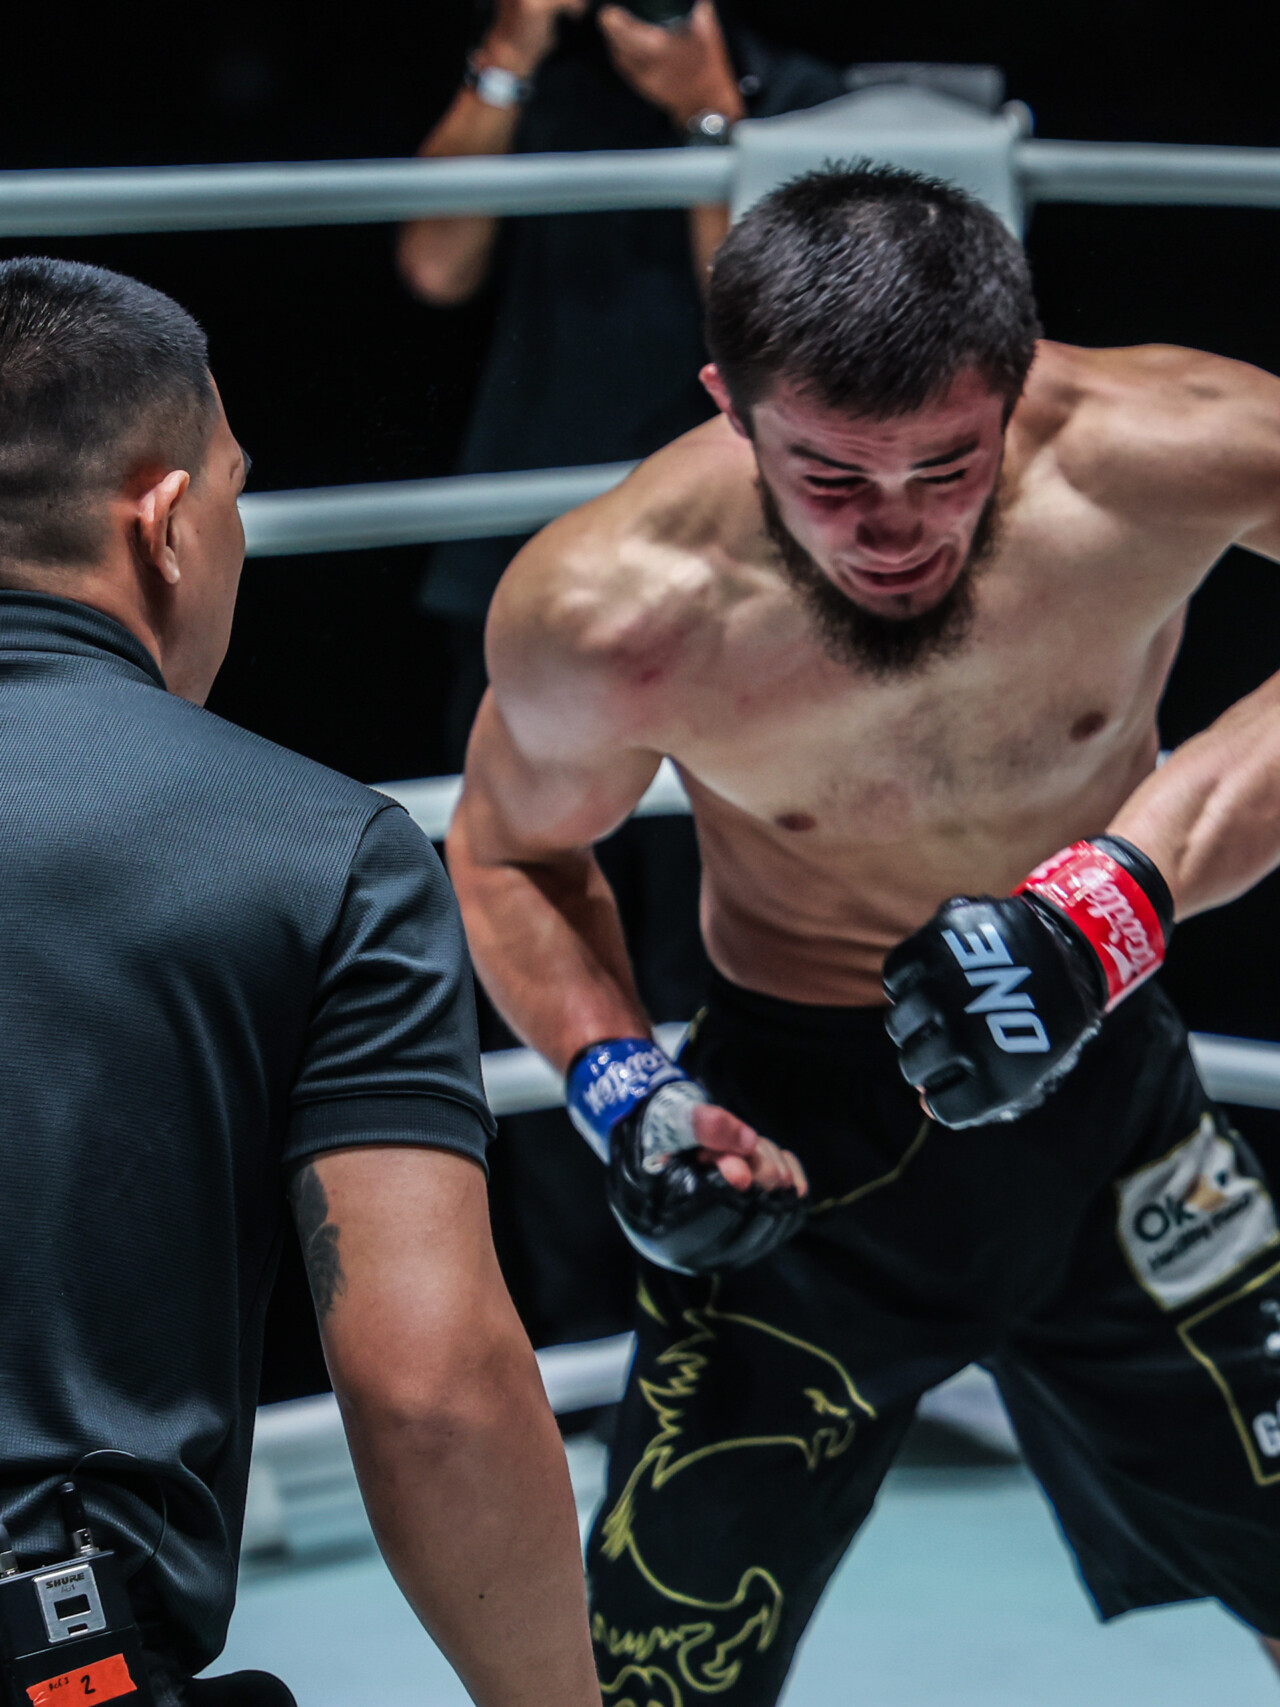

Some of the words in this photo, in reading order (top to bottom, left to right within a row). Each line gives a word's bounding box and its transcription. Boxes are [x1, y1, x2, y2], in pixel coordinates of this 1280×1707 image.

[941, 923, 1050, 1053] ONE
[45, 1572, 85, 1589] SHURE
[81, 1675, 96, 1694] 2
